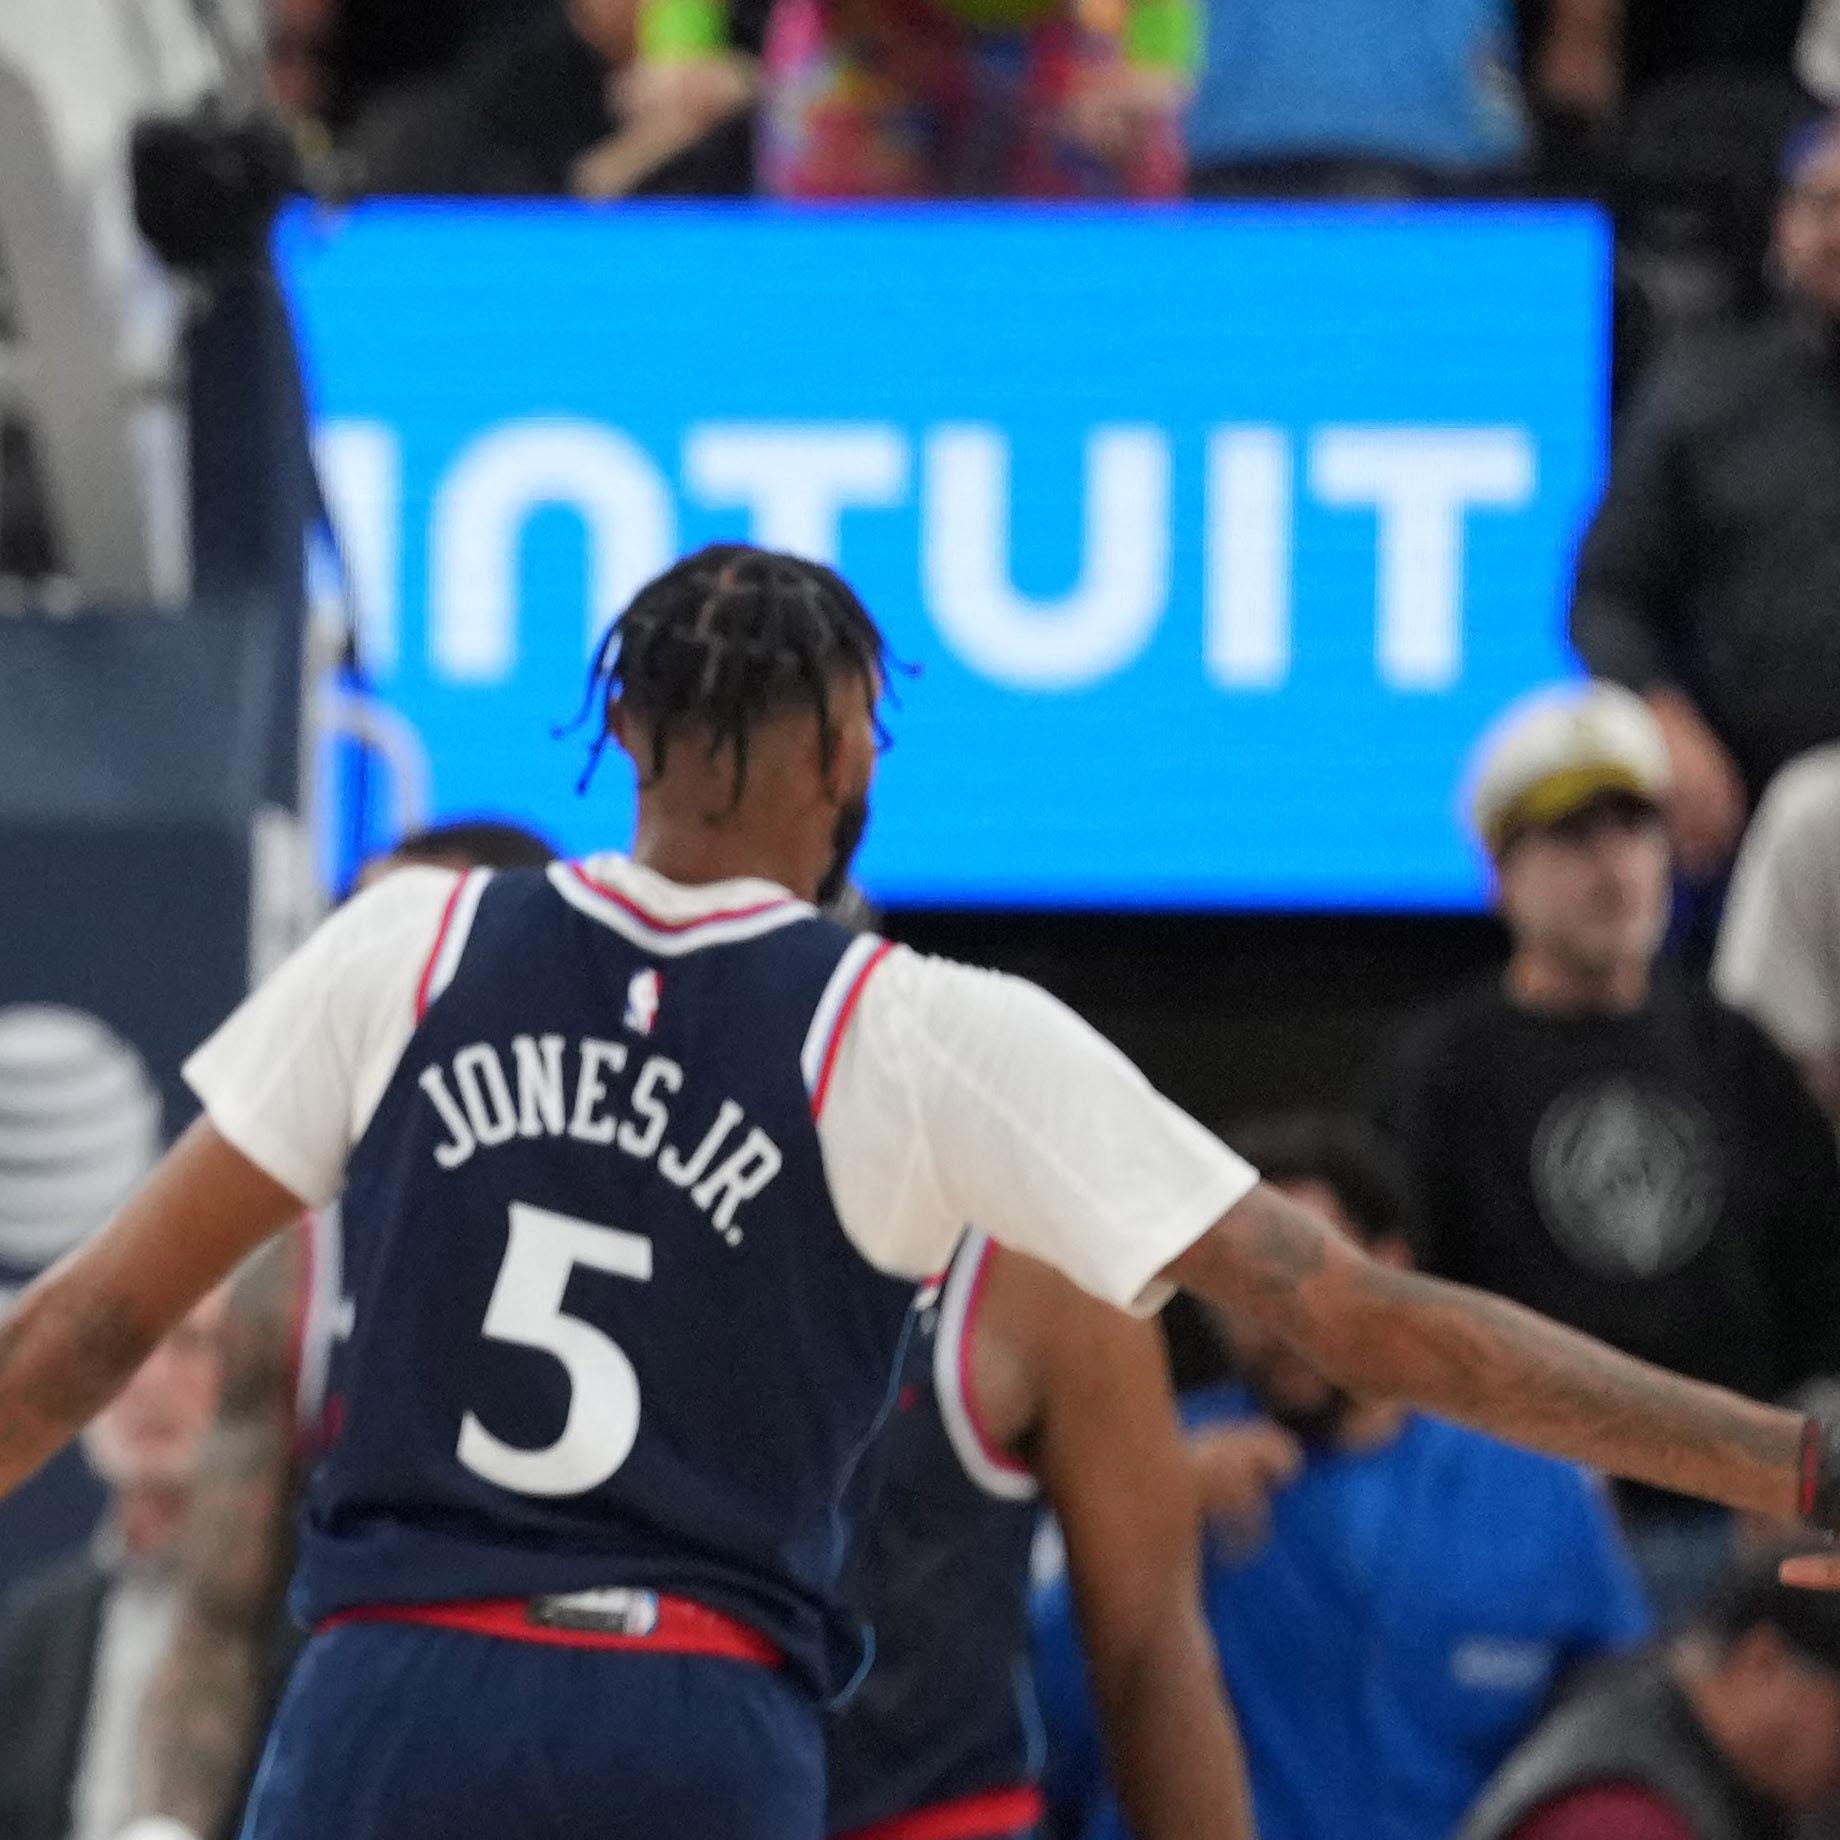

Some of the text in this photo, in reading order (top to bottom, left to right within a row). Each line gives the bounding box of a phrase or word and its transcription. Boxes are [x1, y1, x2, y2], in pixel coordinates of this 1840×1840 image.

[419, 1033, 783, 1247] JONES JR.
[456, 1200, 654, 1497] 5
